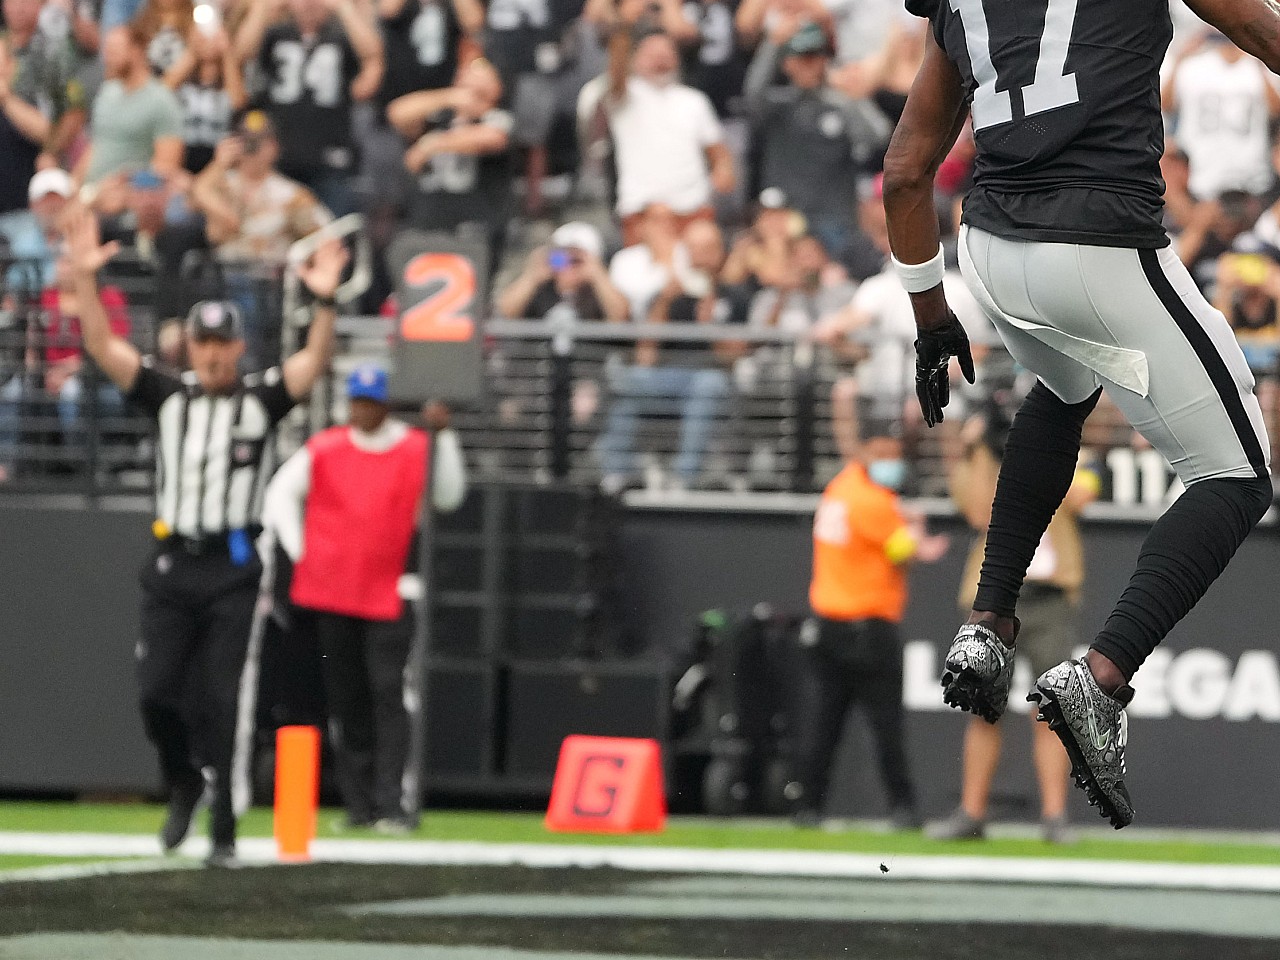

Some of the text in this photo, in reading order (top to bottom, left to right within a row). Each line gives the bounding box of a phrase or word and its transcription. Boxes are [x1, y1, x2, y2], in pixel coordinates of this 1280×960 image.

[270, 40, 342, 107] 34
[402, 252, 476, 342] 2
[572, 755, 626, 818] G
